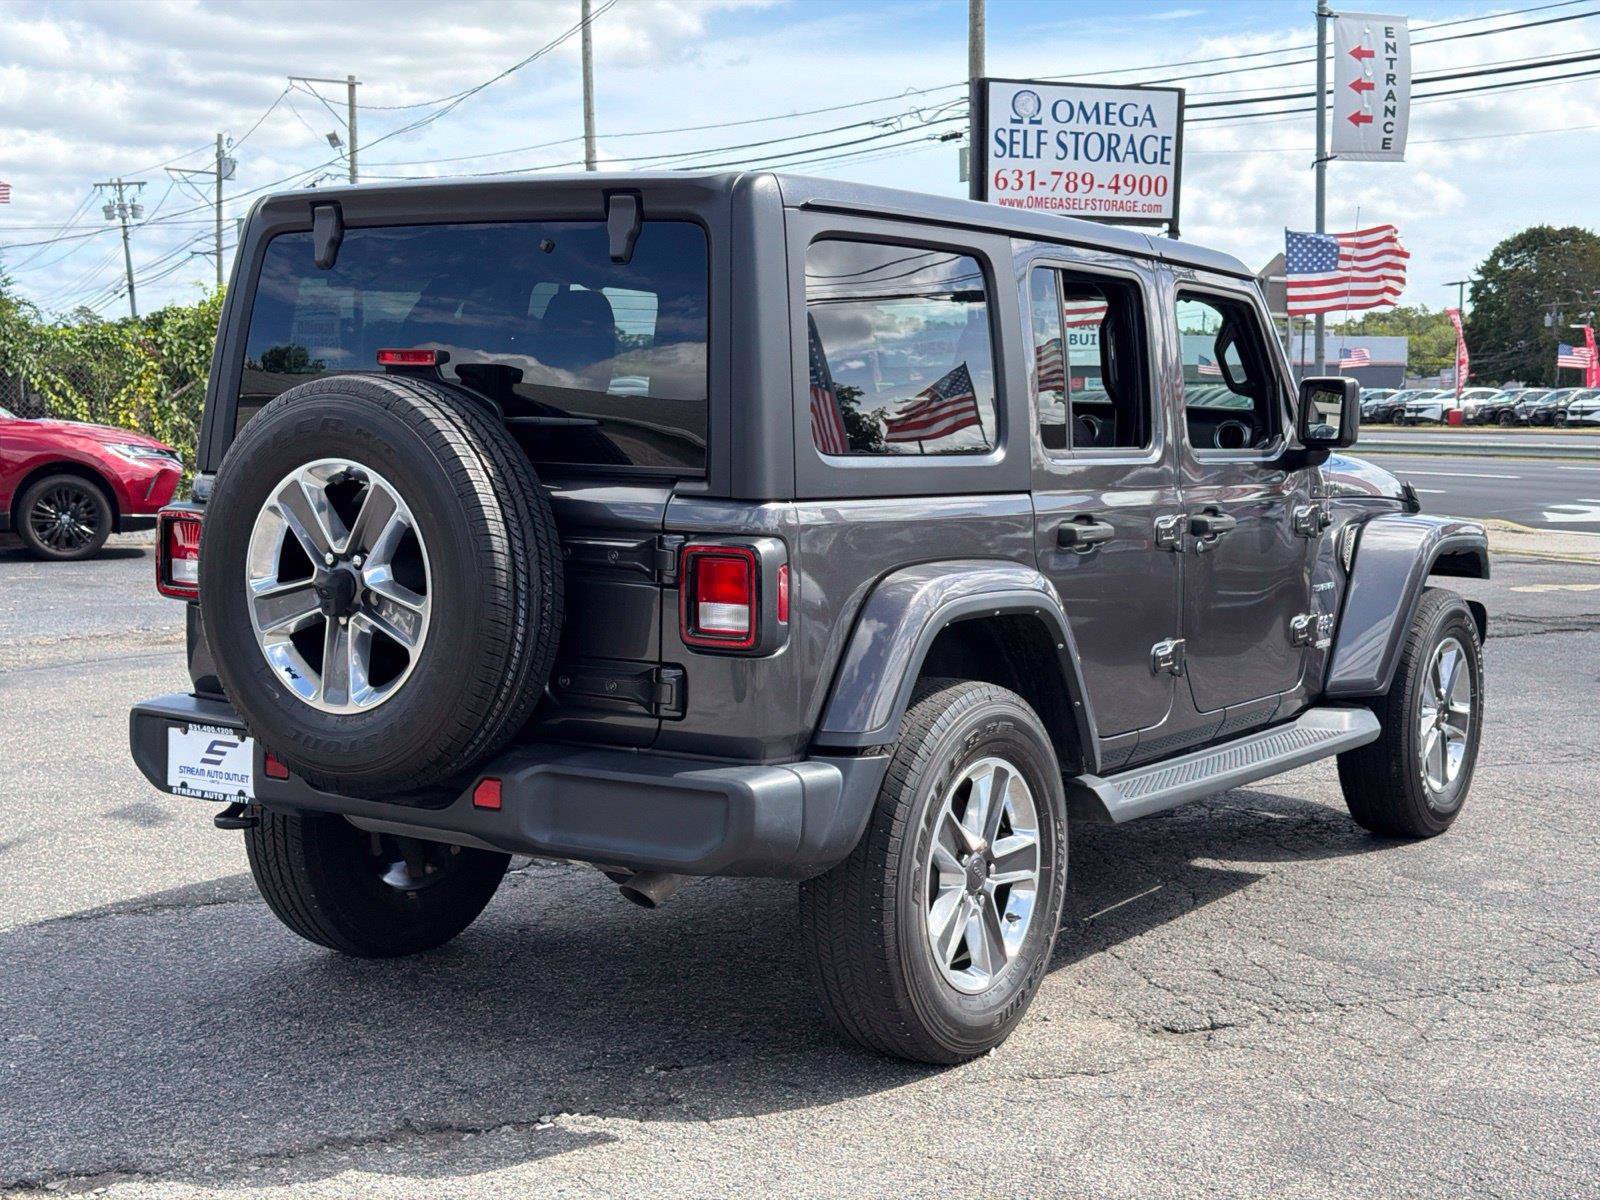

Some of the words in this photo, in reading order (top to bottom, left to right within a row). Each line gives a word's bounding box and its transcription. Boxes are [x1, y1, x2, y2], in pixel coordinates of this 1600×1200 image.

[1381, 26, 1397, 150] ENTRANCE
[1051, 99, 1158, 128] OMEGA
[993, 127, 1048, 159] SELF
[1055, 130, 1172, 166] STORAGE
[994, 168, 1168, 197] 631-789-4900
[178, 765, 205, 776] STREAM
[206, 769, 223, 780] AUTO
[224, 772, 249, 783] OUTLET
[172, 786, 202, 797] STREAM
[203, 791, 224, 801] AUTO
[225, 792, 249, 804] AMITY
